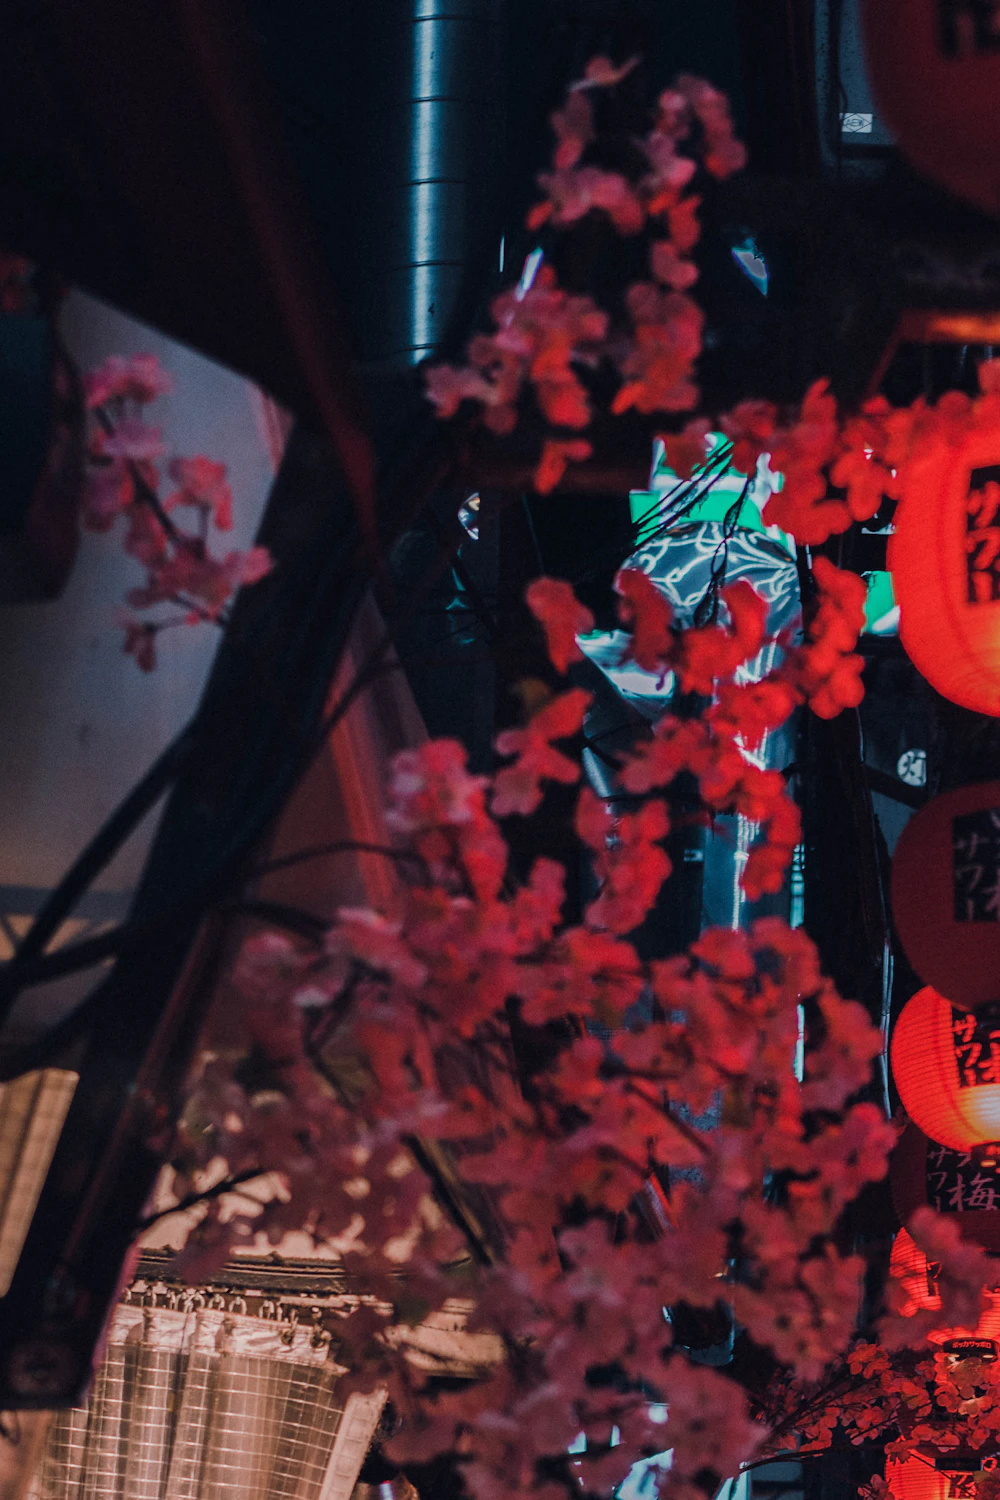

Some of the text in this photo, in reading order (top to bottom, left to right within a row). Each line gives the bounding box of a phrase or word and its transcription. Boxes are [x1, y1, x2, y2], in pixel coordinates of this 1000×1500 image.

[955, 833, 986, 921] サワー
[952, 1013, 982, 1085] サワー
